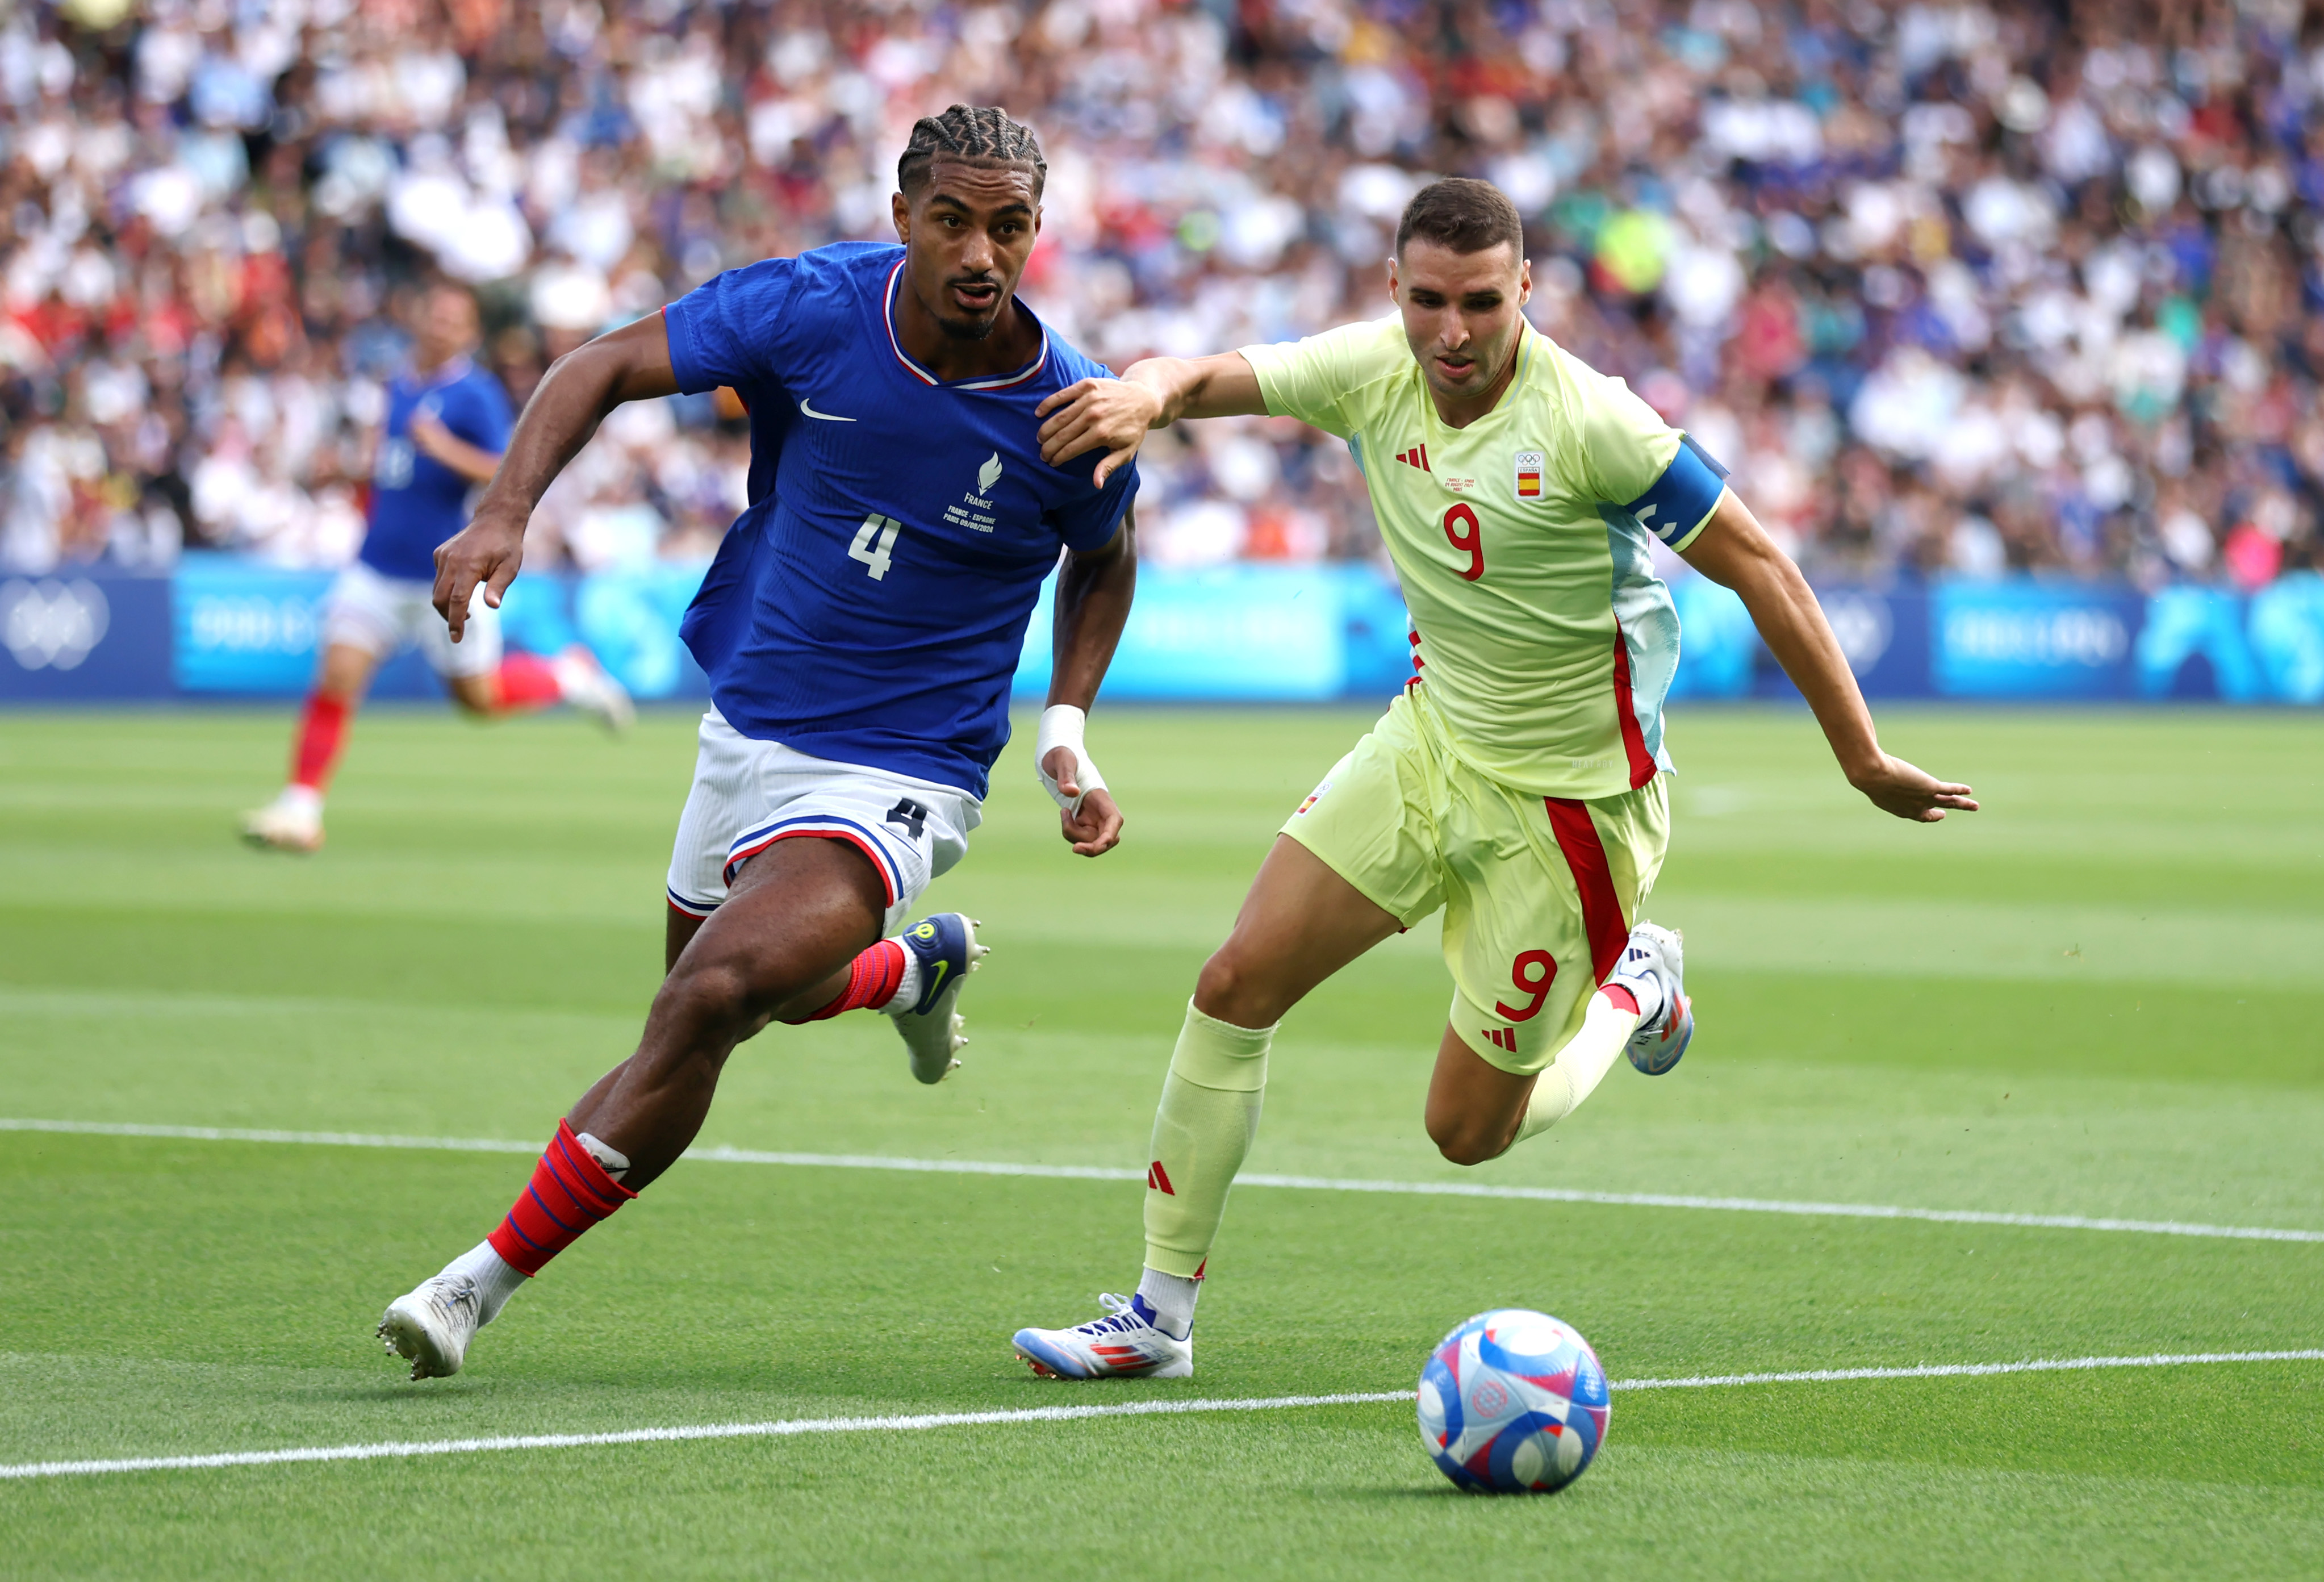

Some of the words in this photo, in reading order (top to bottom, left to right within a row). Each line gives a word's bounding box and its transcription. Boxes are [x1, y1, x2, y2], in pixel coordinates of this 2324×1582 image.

[943, 513, 960, 524] PARIS
[959, 519, 994, 533] 09/08/2024
[947, 505, 969, 517] FRANCE
[972, 514, 996, 524] ESPAGNE
[964, 492, 993, 510] FRANCE
[847, 513, 901, 581] 4
[1443, 503, 1484, 581] 9
[886, 798, 927, 843] 4
[1495, 949, 1558, 1022] 9
